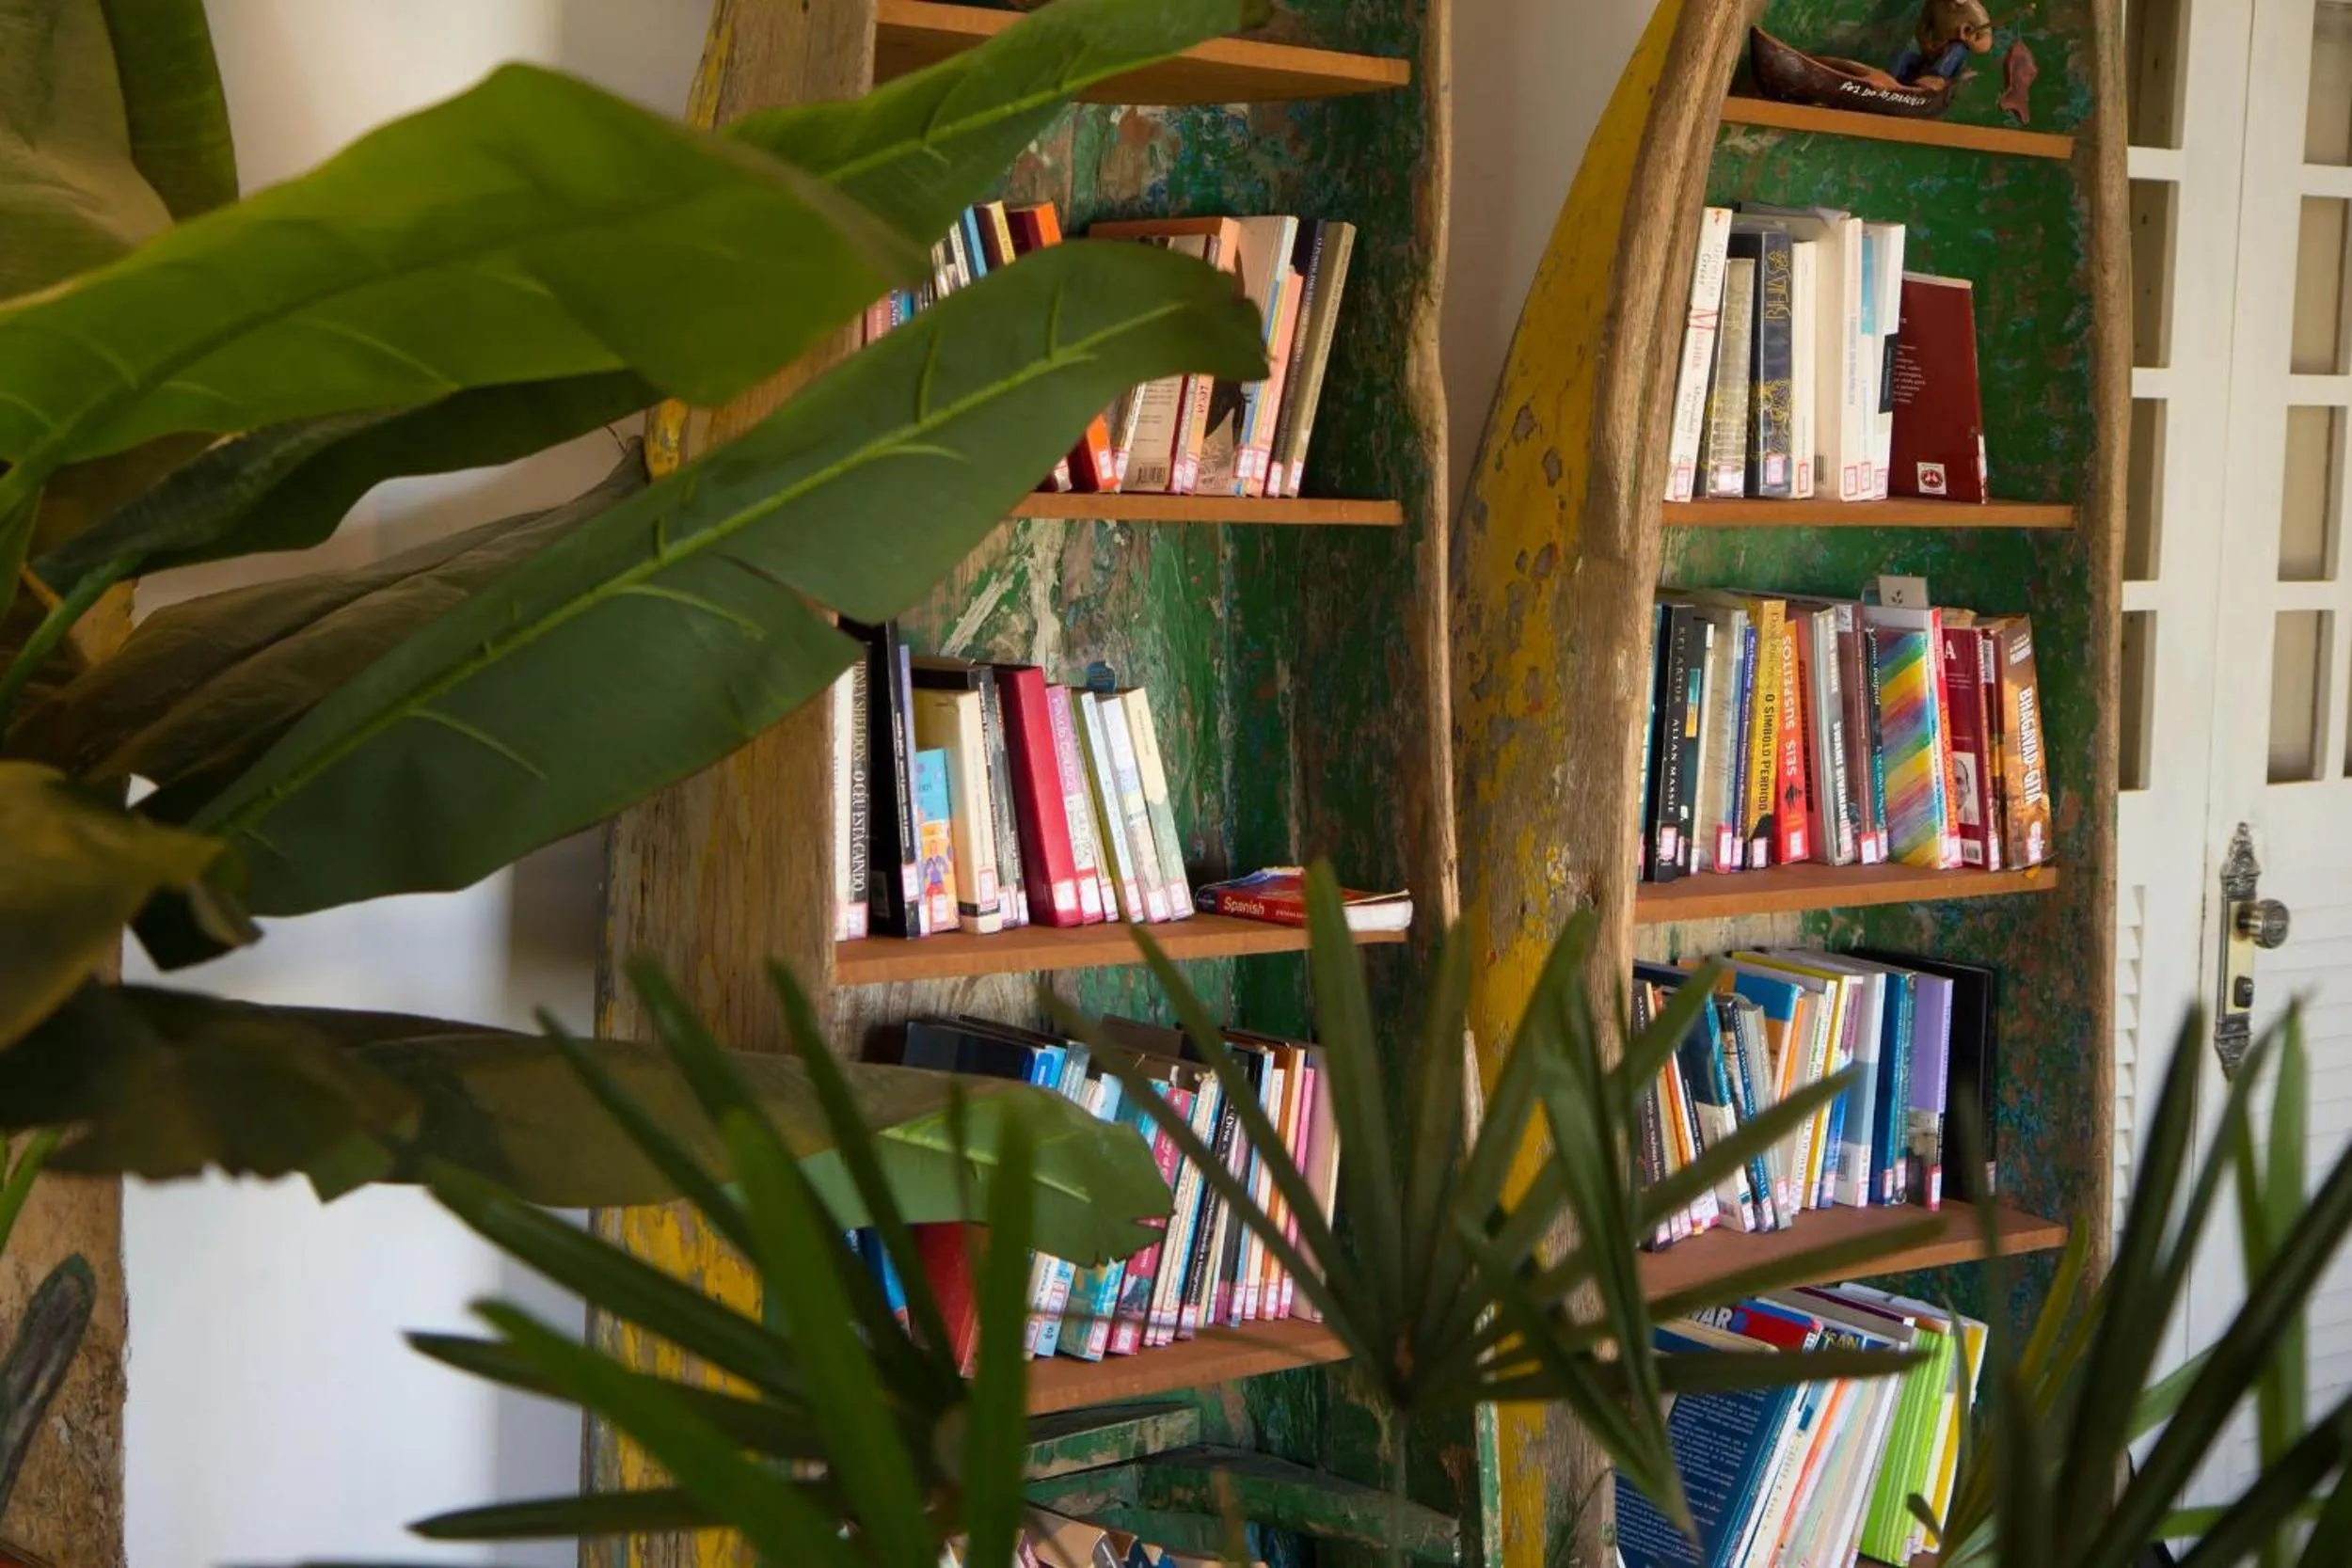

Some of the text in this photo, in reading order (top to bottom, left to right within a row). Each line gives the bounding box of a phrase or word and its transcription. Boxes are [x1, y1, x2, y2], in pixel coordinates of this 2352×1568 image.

[853, 660, 866, 697] IDNEY
[1766, 693, 1776, 703] O
[1782, 636, 1797, 776] SEIS SUSPEITOS
[852, 701, 866, 760] SHELDON
[1670, 719, 1679, 760] ALLAN
[1833, 721, 1844, 766] SWAMI
[1666, 765, 1676, 813] MASSIE
[1758, 760, 1772, 810] PERDIDO
[851, 842, 866, 891] CAINDO
[1224, 896, 1264, 915] Spanish
